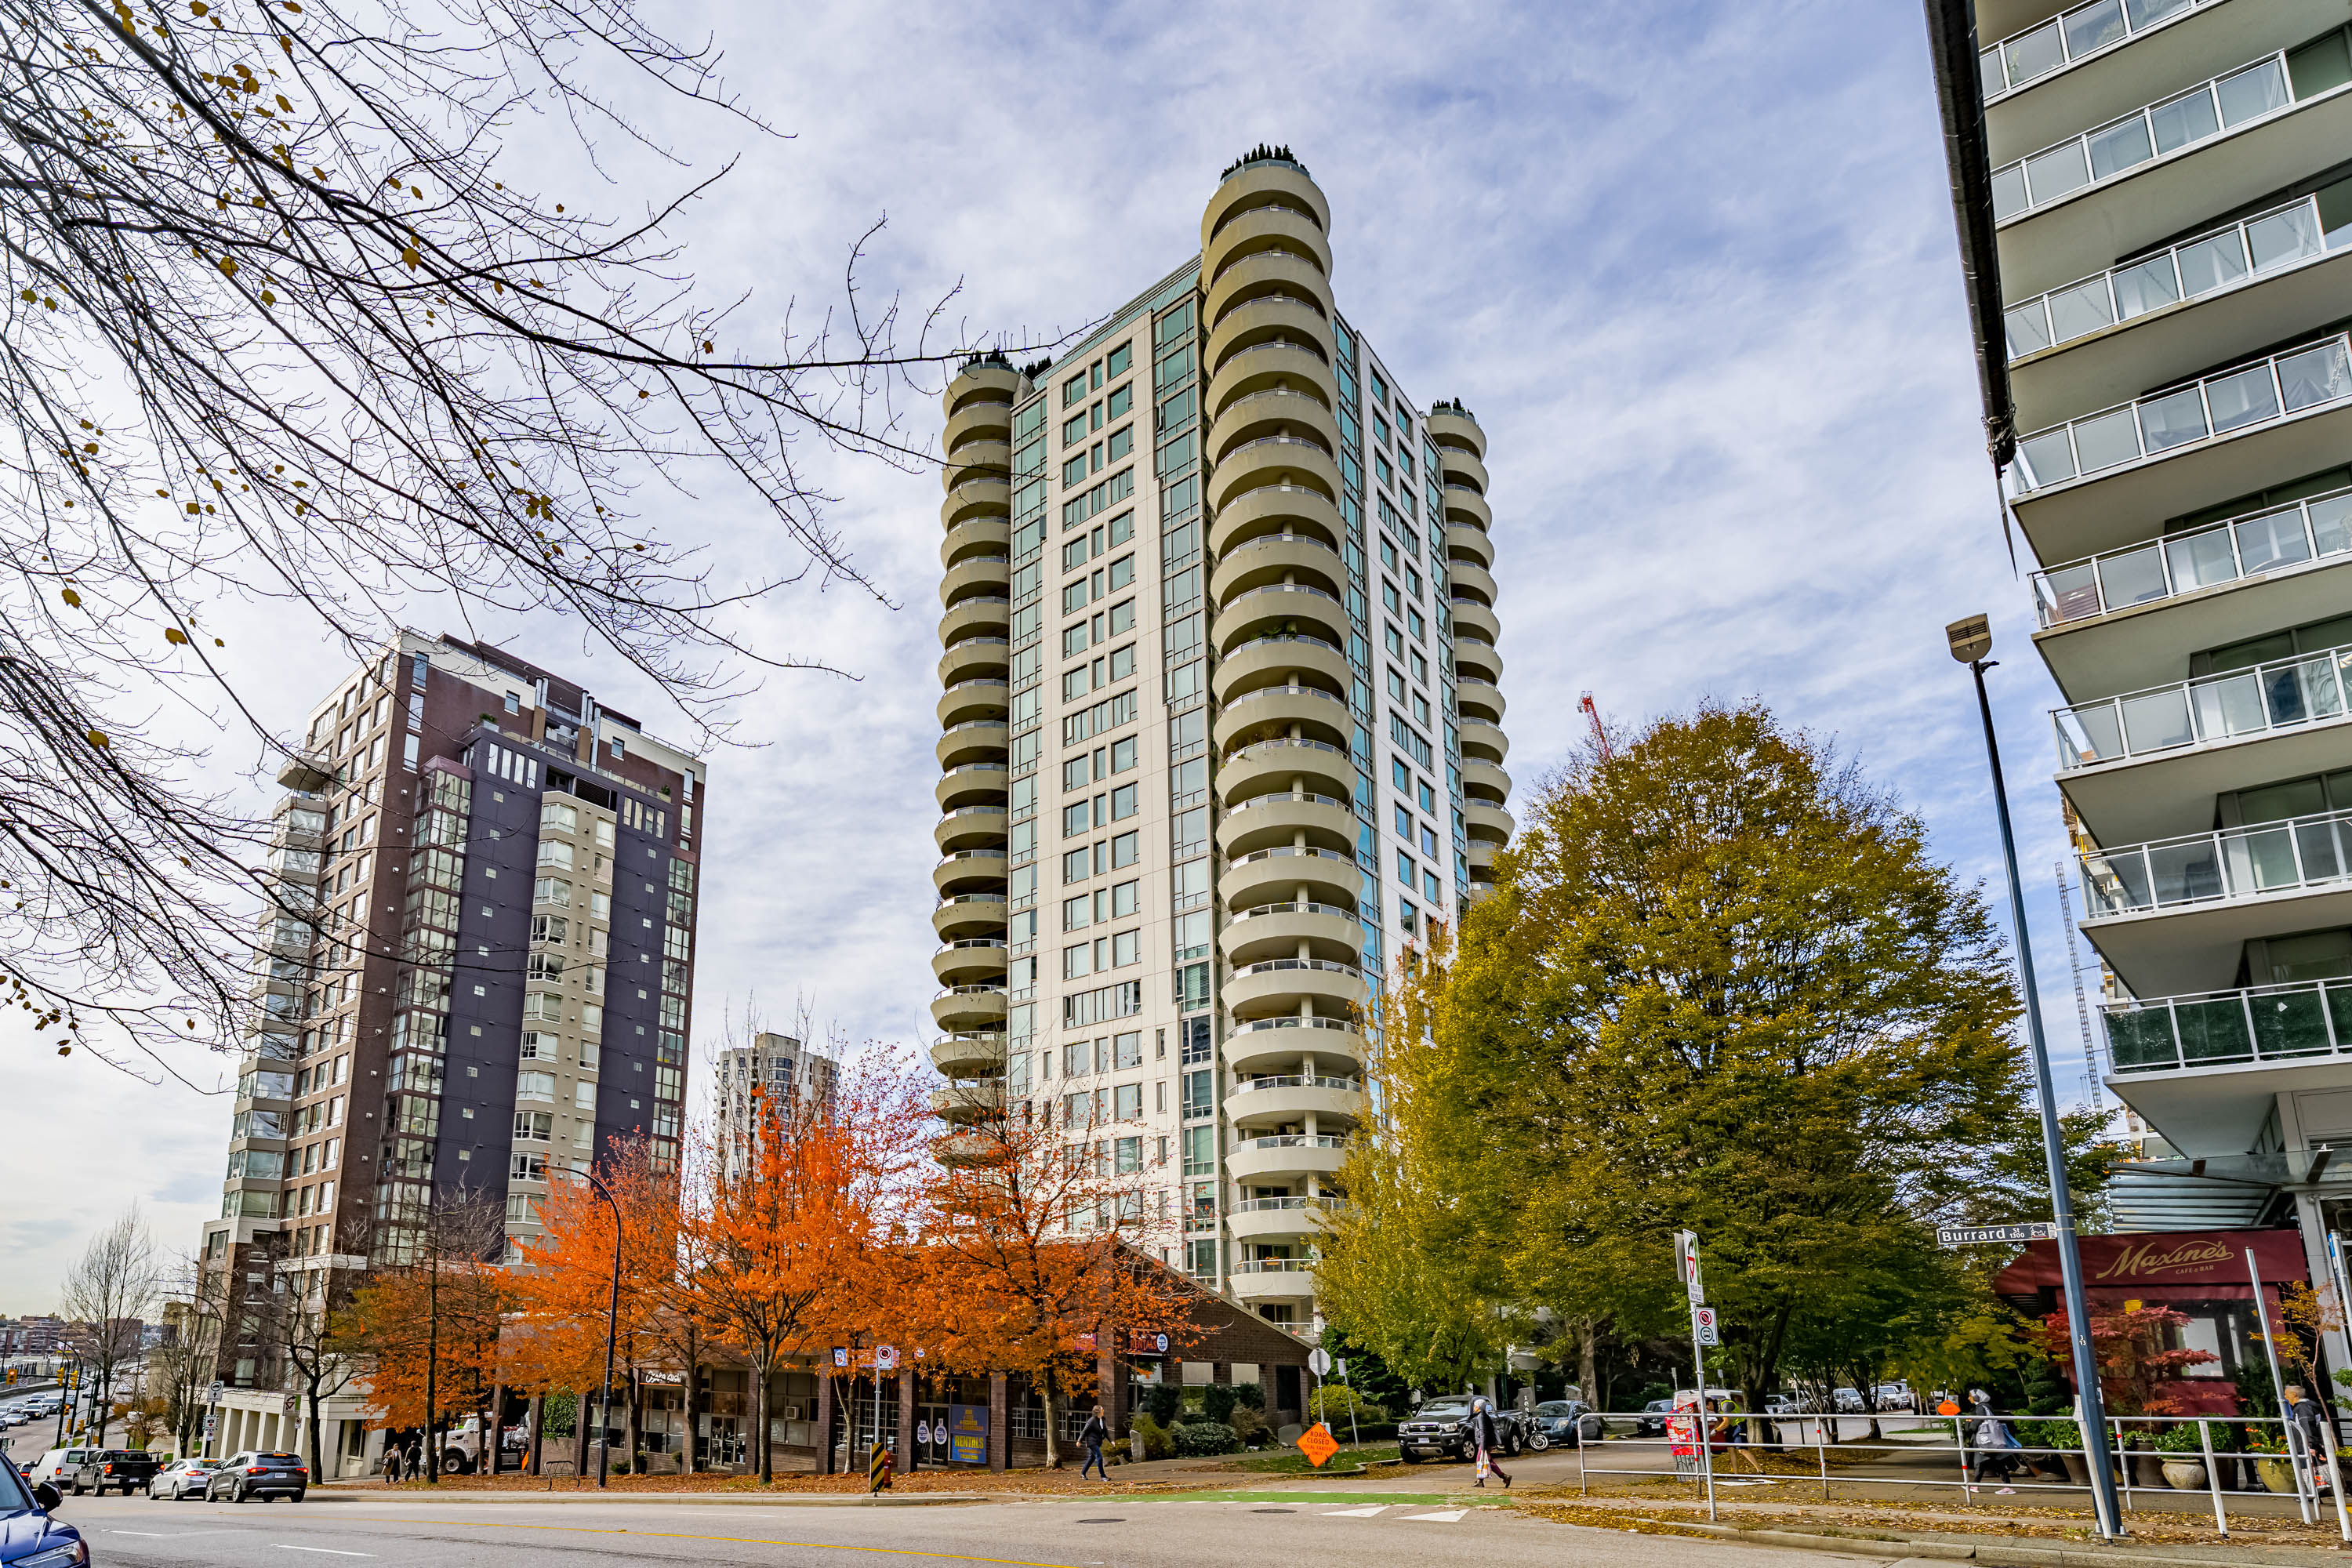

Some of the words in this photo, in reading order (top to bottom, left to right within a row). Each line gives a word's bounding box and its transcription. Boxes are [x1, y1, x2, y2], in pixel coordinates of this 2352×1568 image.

[1941, 1228, 2006, 1242] Burrard
[2096, 1240, 2234, 1279] Maxine's
[954, 1436, 985, 1449] RENTALS
